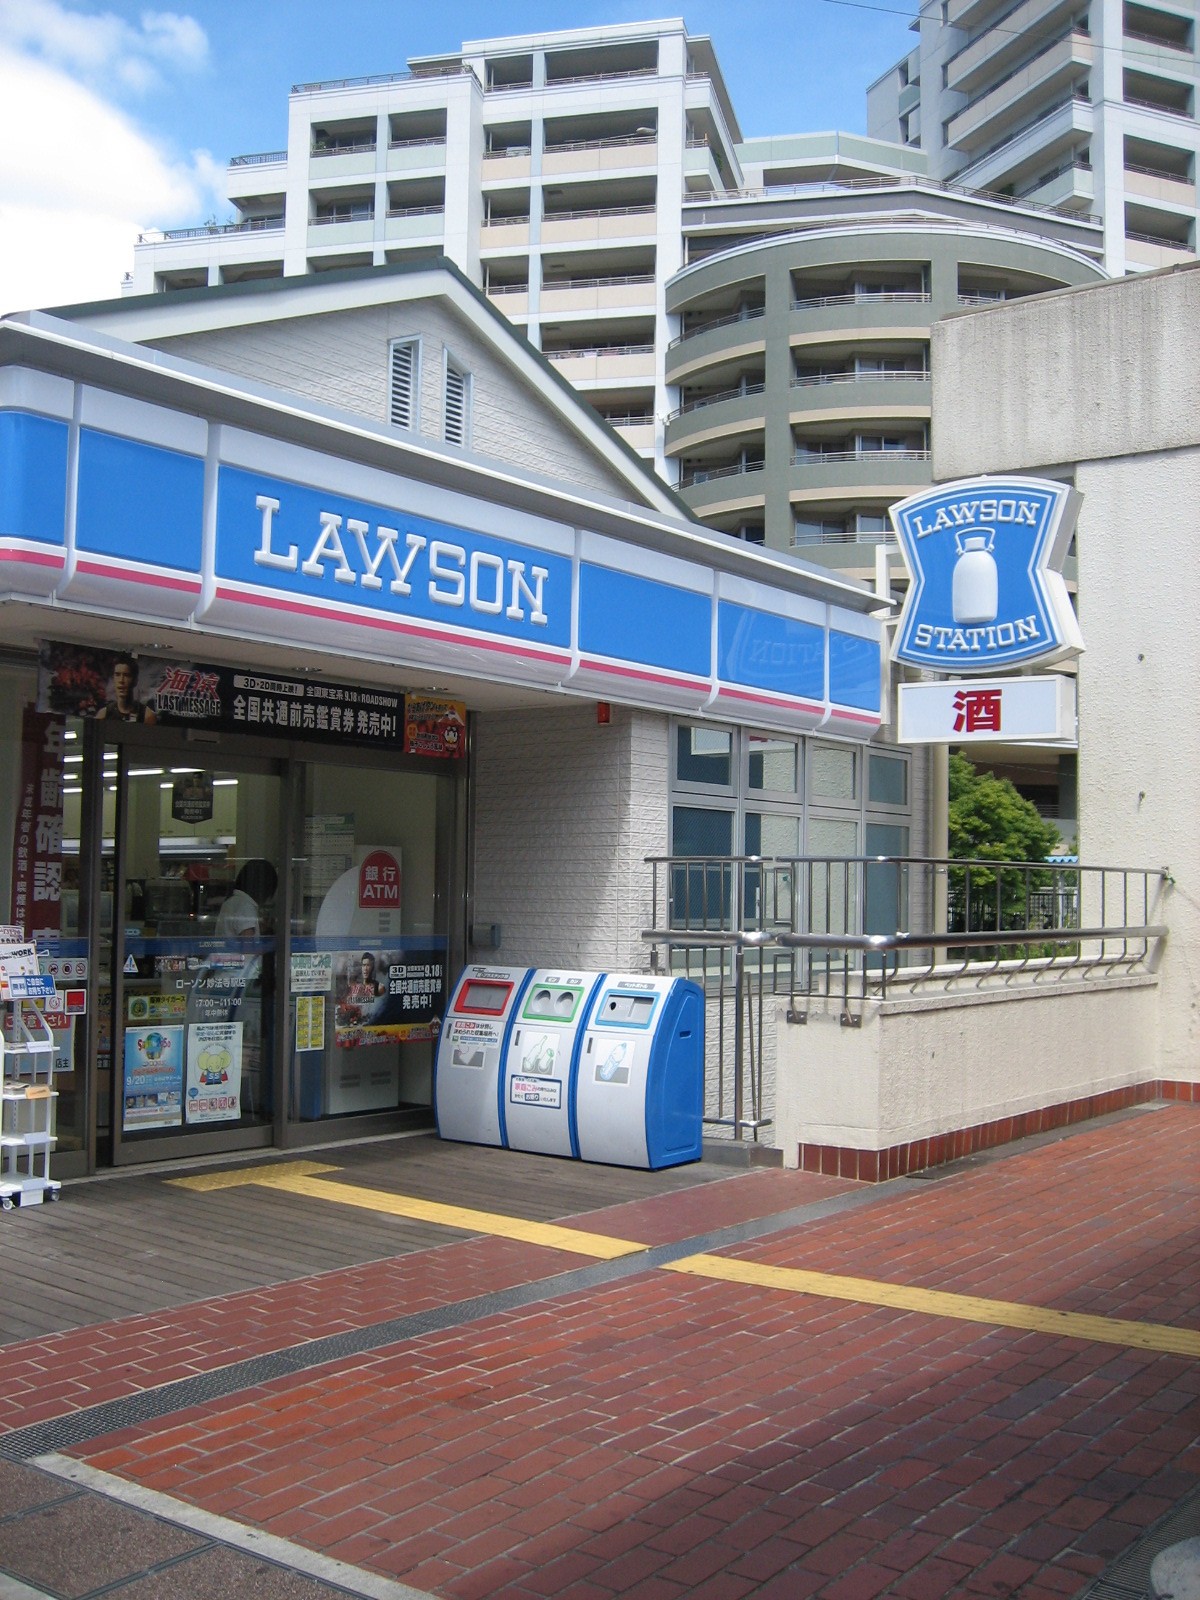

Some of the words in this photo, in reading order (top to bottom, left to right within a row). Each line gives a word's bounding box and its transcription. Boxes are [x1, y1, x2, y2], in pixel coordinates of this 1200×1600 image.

[913, 499, 1040, 540] LAWSON
[253, 494, 550, 626] LAWSON
[914, 614, 1040, 652] STATION
[156, 693, 180, 711] LAST
[182, 696, 220, 716] MESSAGE
[361, 695, 398, 708] ROADSHOW
[233, 694, 354, 733] 全国共通前売鑑賞券
[357, 709, 397, 738] 発売中!
[952, 688, 1002, 733] 酒
[365, 866, 396, 882] 銀行
[363, 884, 398, 899] ATM
[11, 947, 34, 957] WORK
[425, 964, 440, 977] 9.18
[403, 994, 432, 1010] 発売中!
[127, 1076, 146, 1086] 9/20
